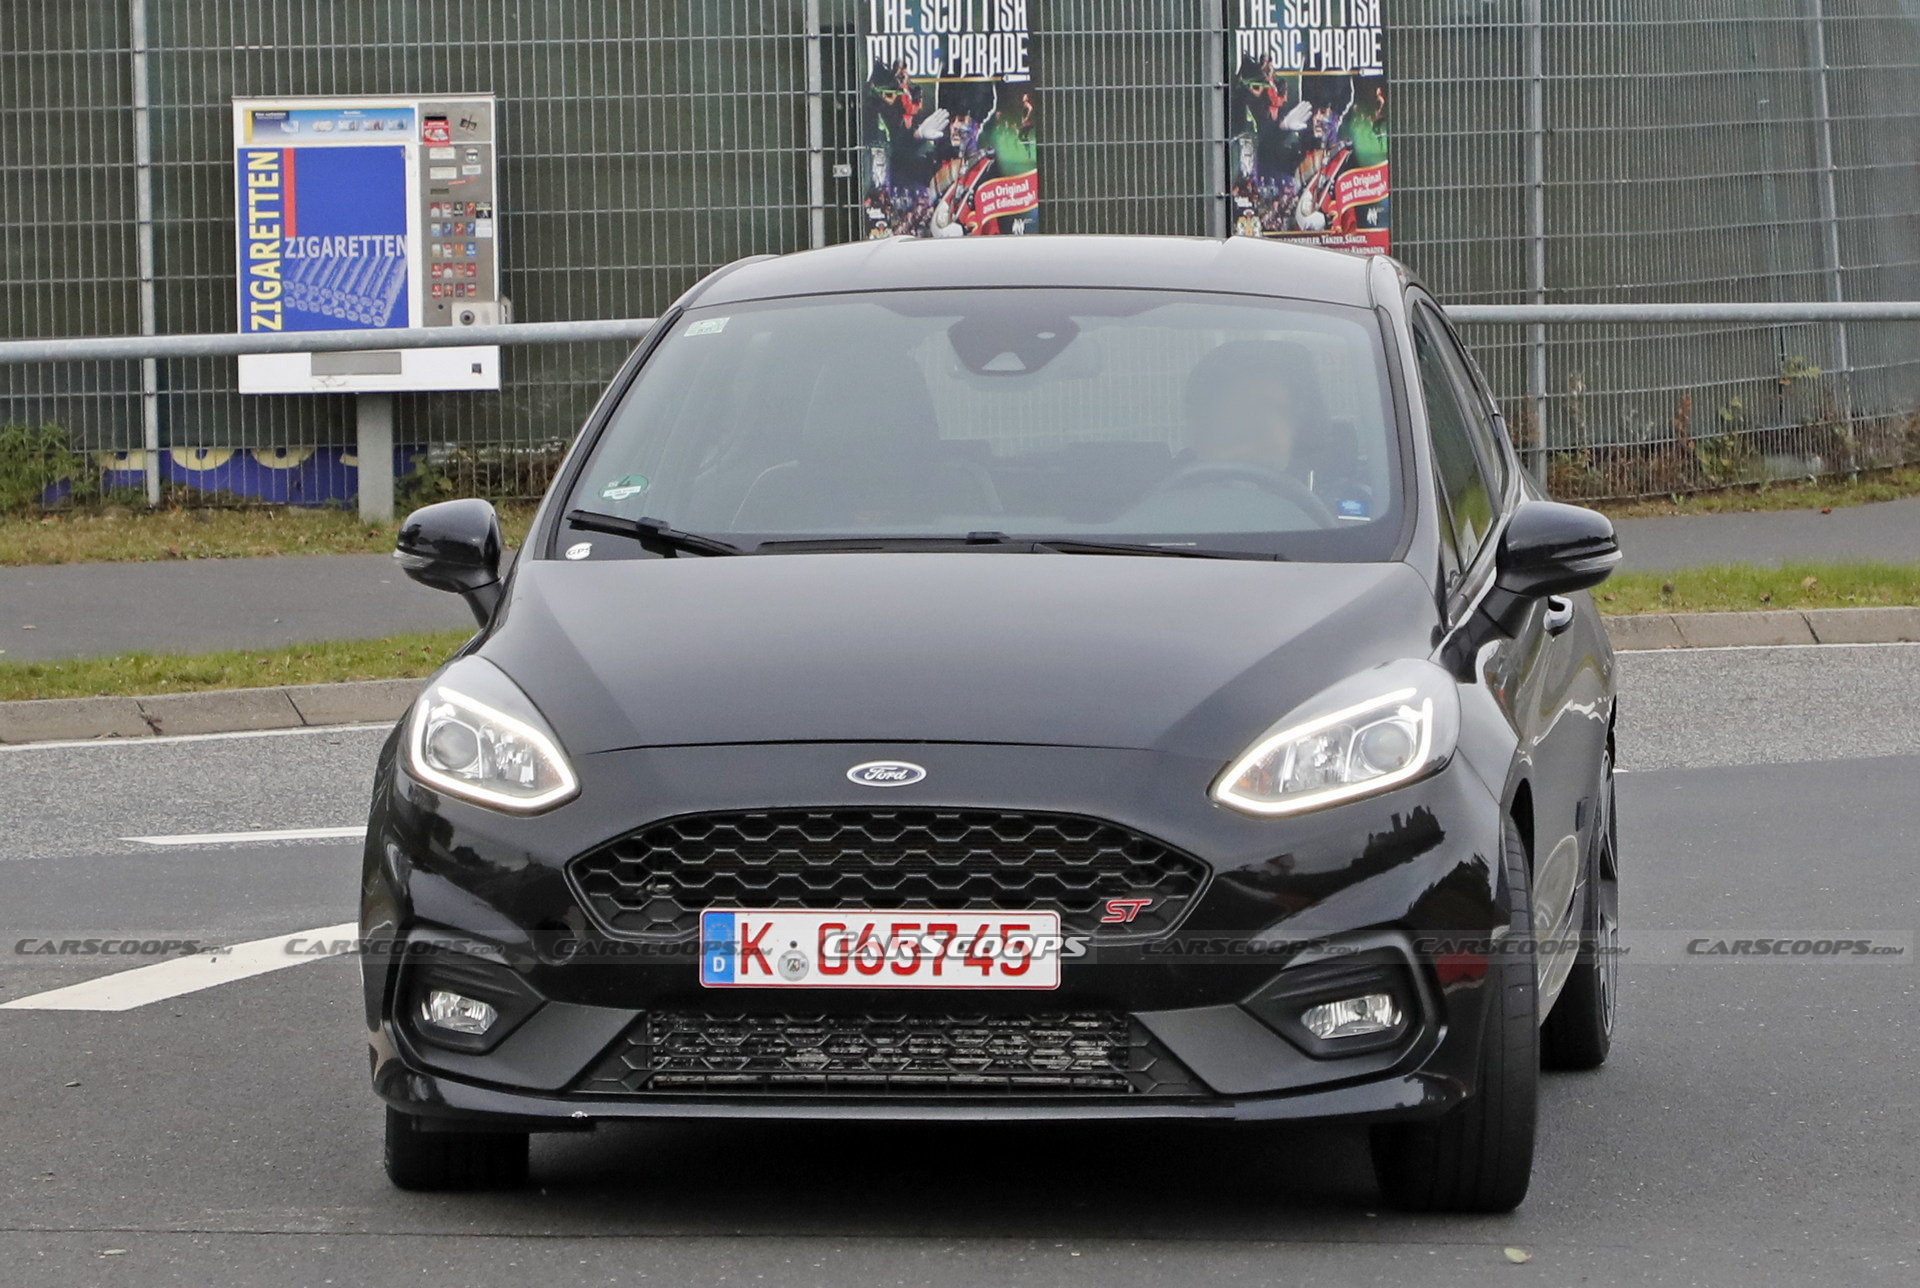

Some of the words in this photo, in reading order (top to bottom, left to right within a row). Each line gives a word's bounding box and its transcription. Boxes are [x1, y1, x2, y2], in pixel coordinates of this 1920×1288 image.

[870, 0, 914, 34] THE
[920, 0, 1028, 33] SCOTTISH
[1239, 0, 1277, 28] THE
[1283, 0, 1381, 28] SCOTTISH
[865, 34, 939, 82] MUSIC
[948, 33, 1030, 78] PARADE
[1235, 29, 1301, 75] MUSIC
[1309, 28, 1383, 72] PARADE
[981, 191, 995, 202] Das
[996, 179, 1029, 199] Original
[1353, 170, 1381, 190] Original
[248, 151, 282, 331] ZIGARETTEN
[284, 234, 408, 259] ZIGARETTEN
[864, 766, 908, 780] Ford
[1101, 899, 1153, 923] ST
[740, 922, 774, 975] K
[712, 956, 725, 973] D
